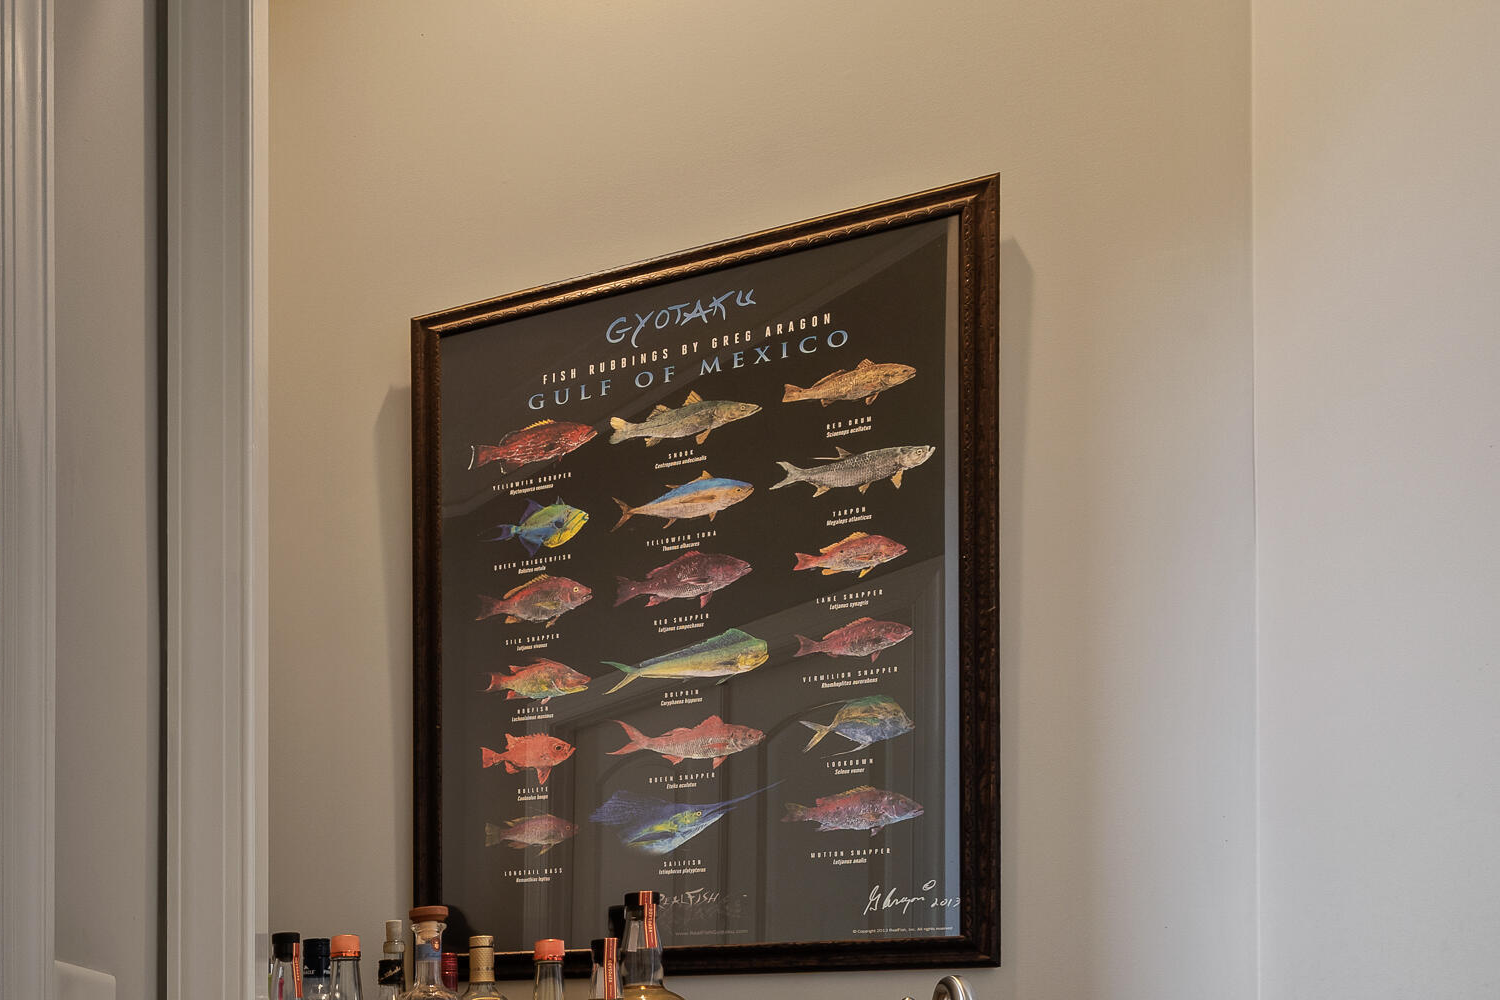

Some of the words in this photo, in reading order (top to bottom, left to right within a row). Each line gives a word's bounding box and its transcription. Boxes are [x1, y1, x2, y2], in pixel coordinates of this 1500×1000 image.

[605, 289, 756, 348] GYOTAKU
[543, 369, 577, 385] FISH
[589, 348, 668, 375] RUBBINGS
[682, 342, 698, 356] BY
[711, 331, 751, 348] GREG
[765, 313, 831, 337] ARAGON
[528, 379, 611, 410] GULF
[635, 366, 675, 388] OF
[700, 330, 848, 376] MEXICO
[826, 421, 842, 430] RED
[848, 416, 871, 426] DRUM
[493, 479, 533, 491] YELLOWFIN
[539, 472, 571, 482] GROUPER
[832, 506, 866, 517] TARPON
[647, 534, 690, 546] YELLOWFIN
[697, 530, 716, 538] TUNA
[816, 595, 836, 604] LANE
[844, 589, 882, 600] SNAPPER
[654, 618, 667, 626] RED
[674, 613, 709, 623] SNAPPER
[527, 633, 560, 643] SNAPPER
[803, 672, 851, 683] VERMILION
[858, 666, 898, 677] SNAPPER
[664, 689, 699, 698] DOLPHIN
[517, 706, 549, 714] HOGFISH
[827, 758, 873, 768] LOOKDOWN
[679, 772, 715, 781] SNAPPER
[851, 848, 890, 856] SNAPPER
[663, 859, 701, 867] SAILFISH
